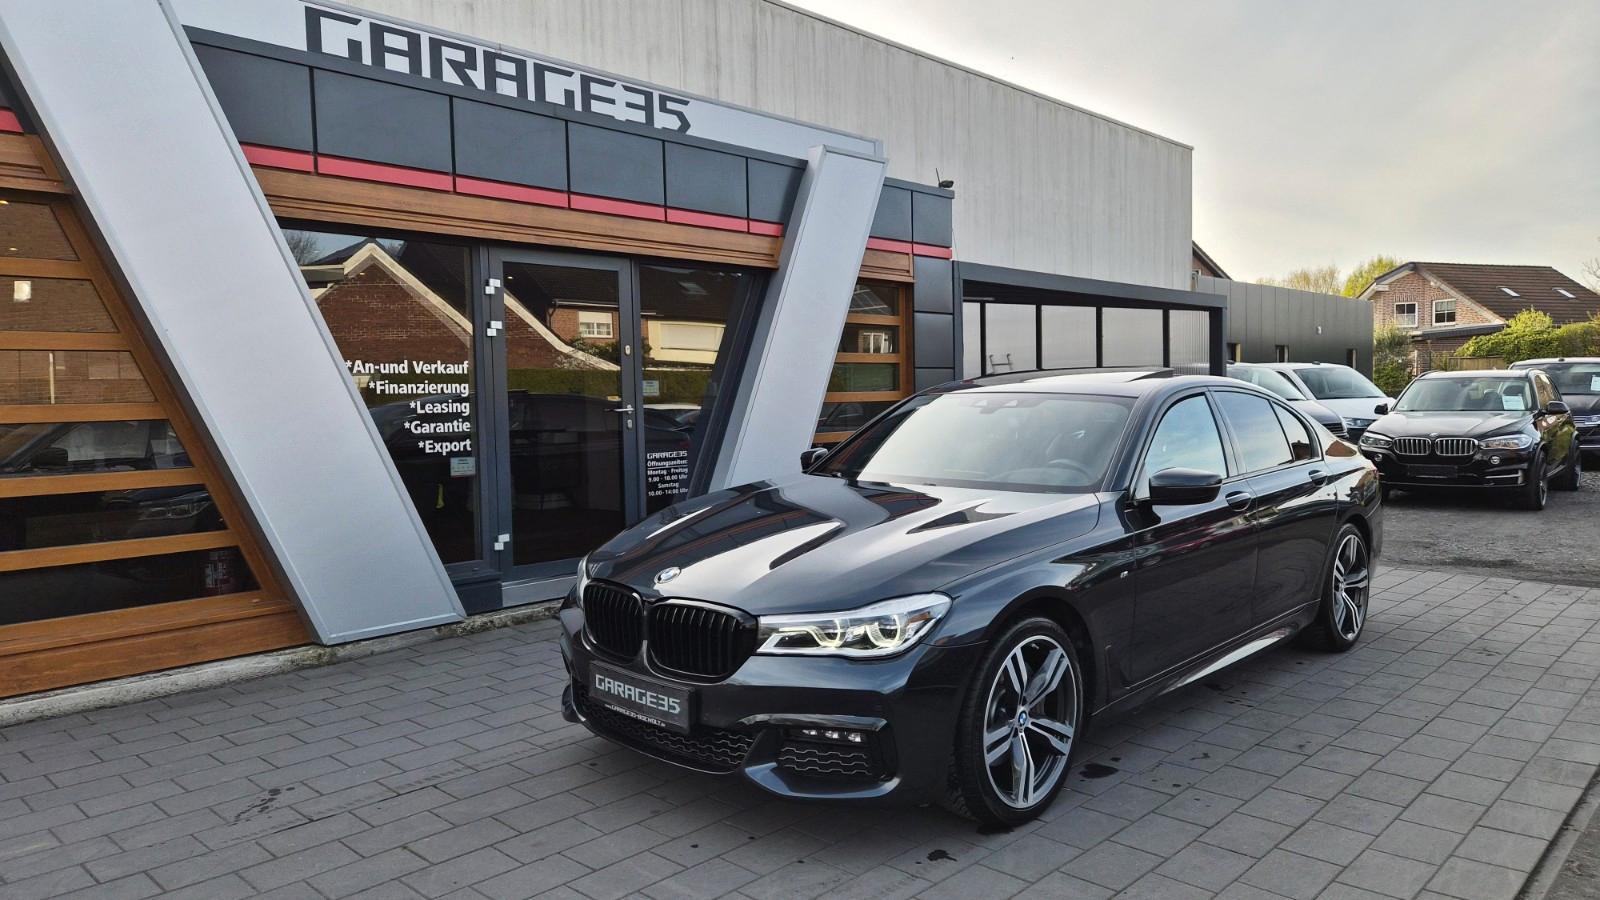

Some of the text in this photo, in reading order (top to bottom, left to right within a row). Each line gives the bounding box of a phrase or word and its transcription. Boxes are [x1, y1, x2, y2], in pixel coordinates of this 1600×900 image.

[305, 6, 692, 136] GARAGE35
[413, 361, 469, 374] Verkauf
[595, 674, 681, 714] GARAGE35
